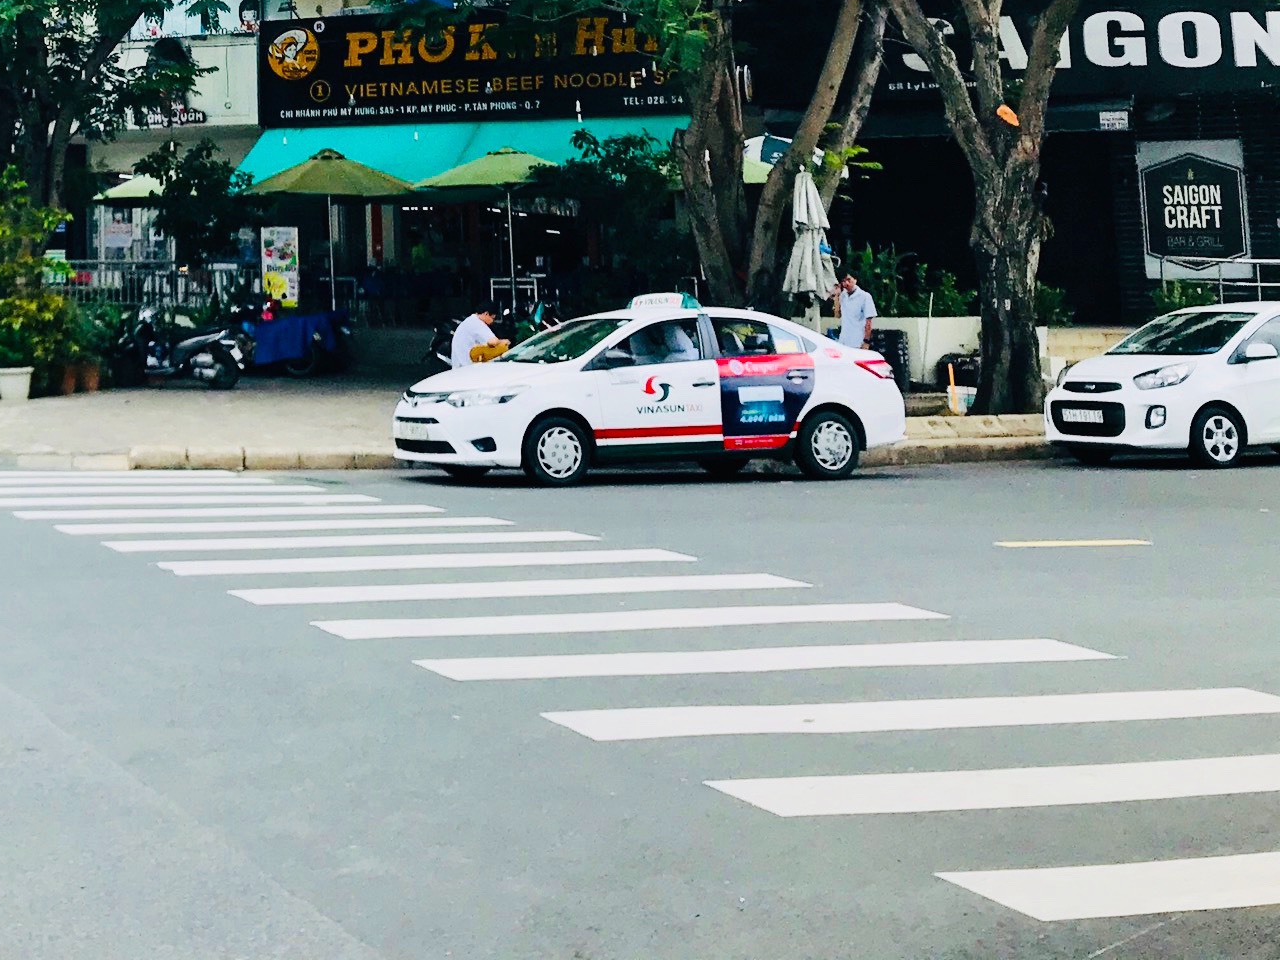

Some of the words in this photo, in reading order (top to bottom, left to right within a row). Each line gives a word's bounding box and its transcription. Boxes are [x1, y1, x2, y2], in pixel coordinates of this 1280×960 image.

[344, 78, 480, 99] VIETNAMESE
[492, 75, 544, 92] BEEF
[553, 71, 643, 89] NOODLE
[280, 109, 294, 119] CHI
[489, 101, 518, 111] PHONG
[622, 96, 644, 106] TEL:
[1162, 184, 1222, 205] SAIGON
[1164, 205, 1223, 229] CRAFT
[1196, 235, 1225, 247] GRILL
[636, 403, 685, 415] VINASUN
